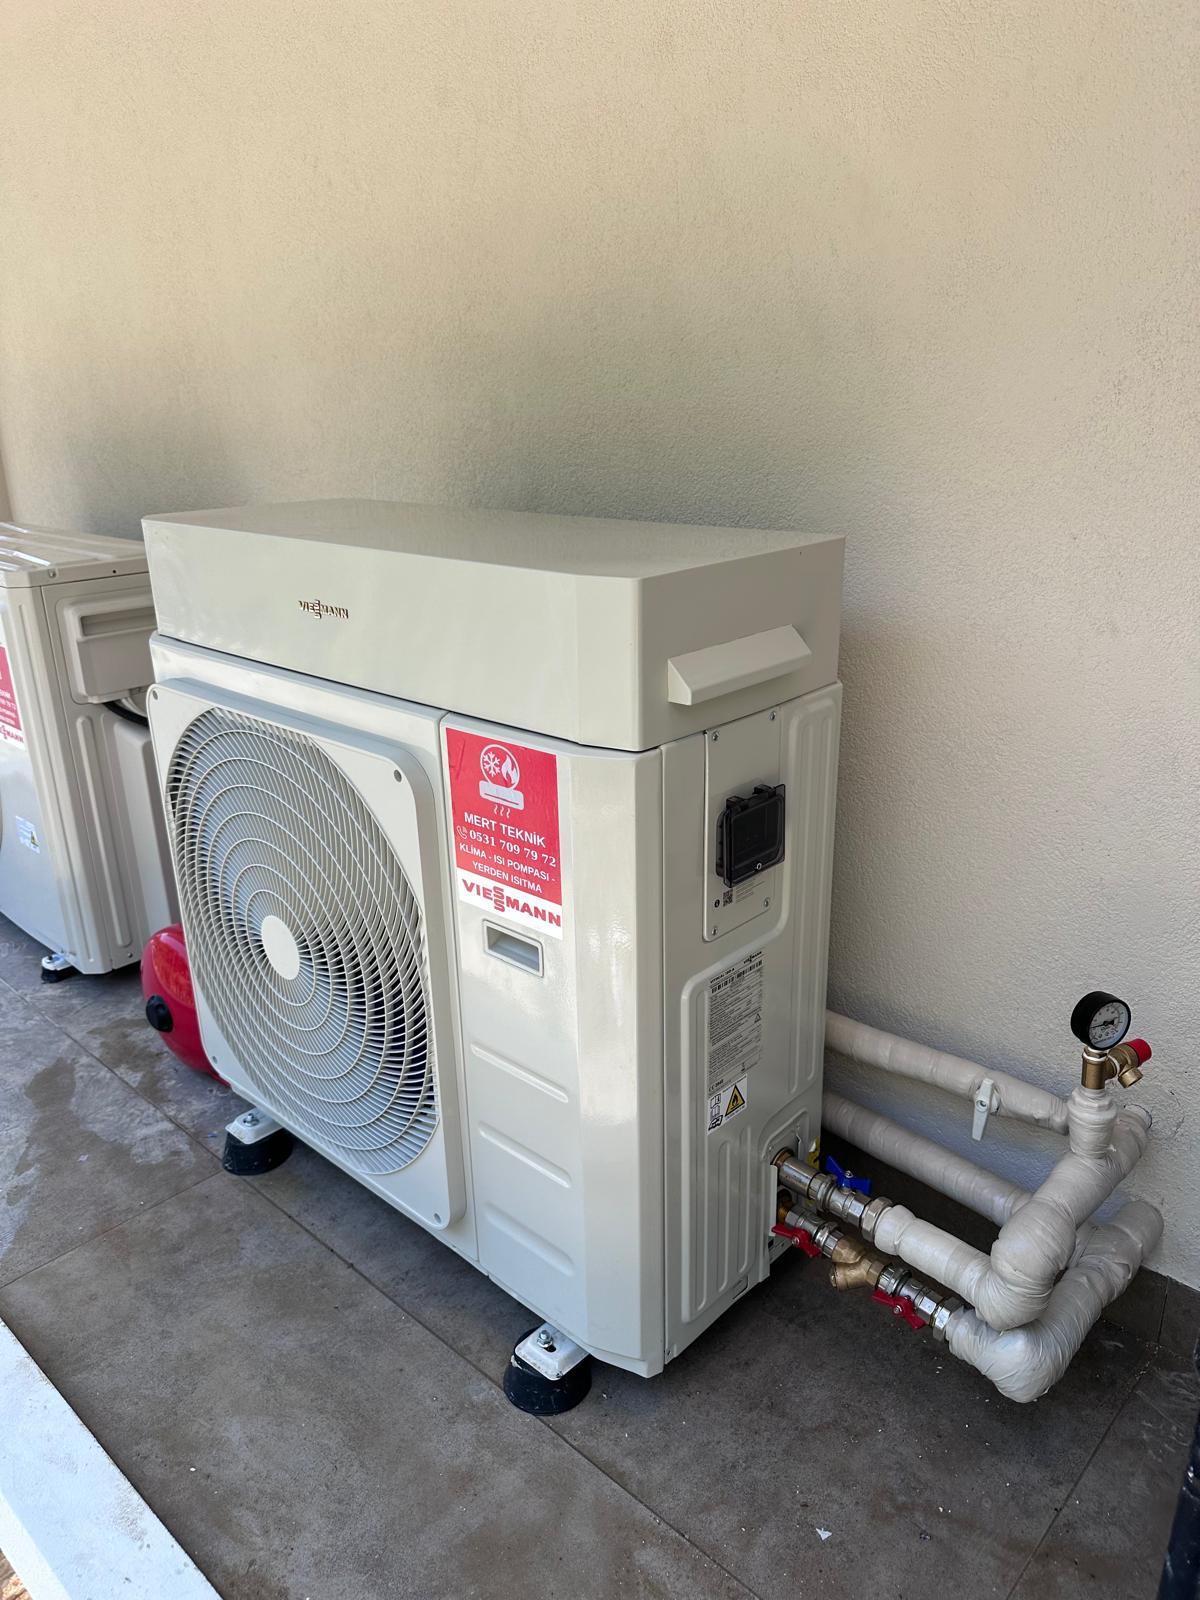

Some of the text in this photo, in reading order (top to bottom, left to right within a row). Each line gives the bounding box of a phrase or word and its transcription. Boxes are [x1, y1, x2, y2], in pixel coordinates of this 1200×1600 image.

[298, 599, 349, 619] VIESSMANN
[464, 812, 546, 848] MERT TEKNİK
[459, 843, 487, 860] KLİMA
[493, 854, 505, 866] ISI
[507, 859, 549, 881] POMPASI
[469, 830, 557, 868] 0531 709 79 72
[472, 860, 543, 894] YERDEN ISITMA
[461, 878, 561, 927] VIESSMANN
